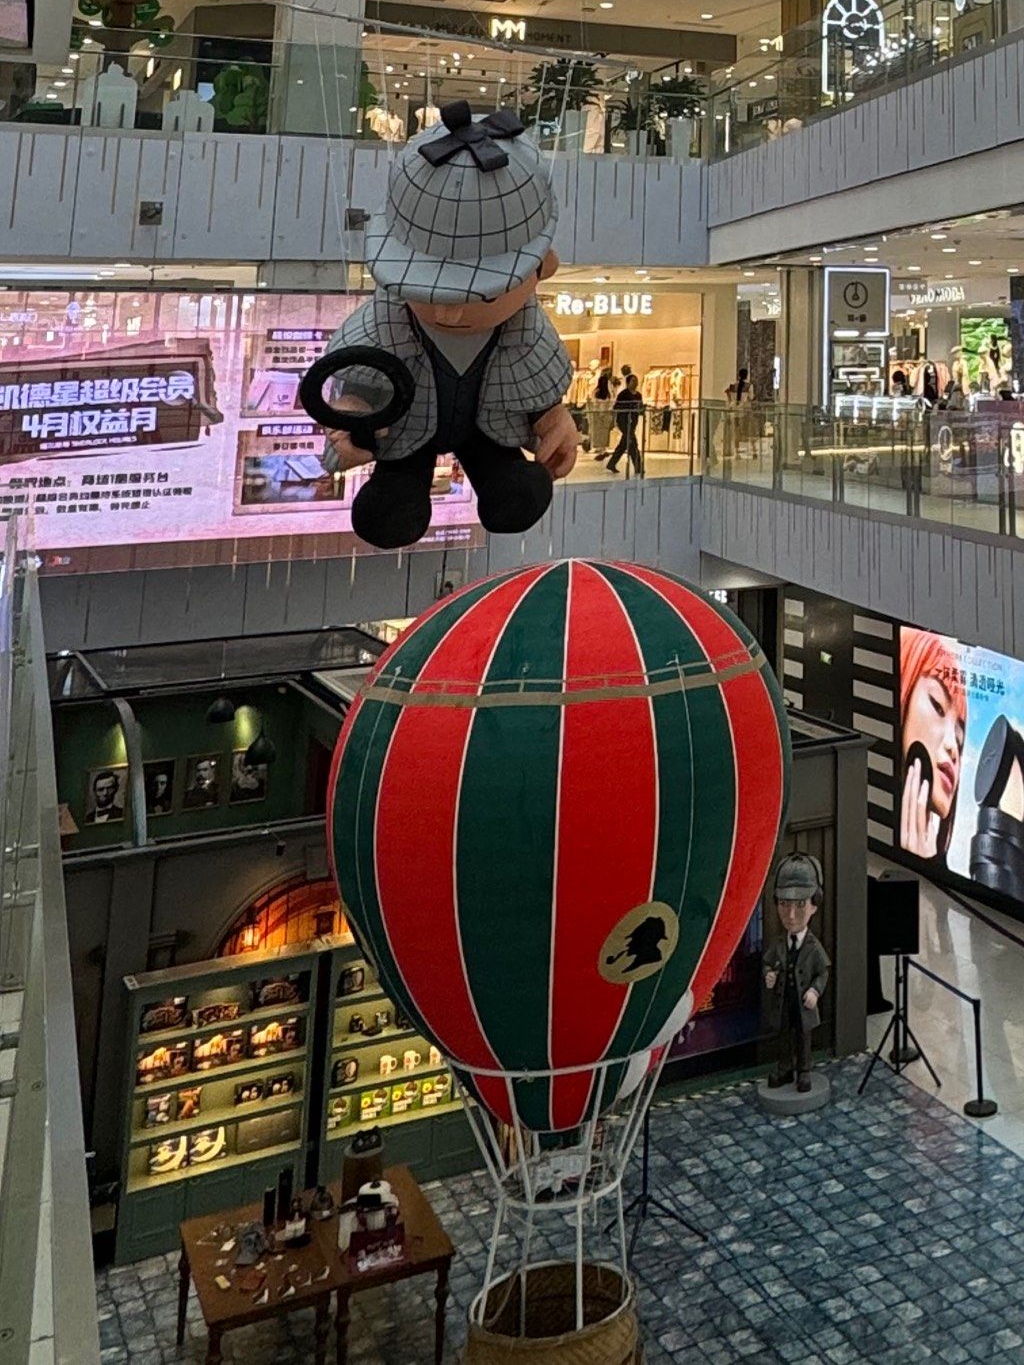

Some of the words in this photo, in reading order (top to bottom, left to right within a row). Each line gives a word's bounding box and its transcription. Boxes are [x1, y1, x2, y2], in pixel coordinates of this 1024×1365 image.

[491, 18, 526, 41] MM
[556, 292, 654, 316] Re-BLUE
[22, 406, 157, 439] 4月权益月
